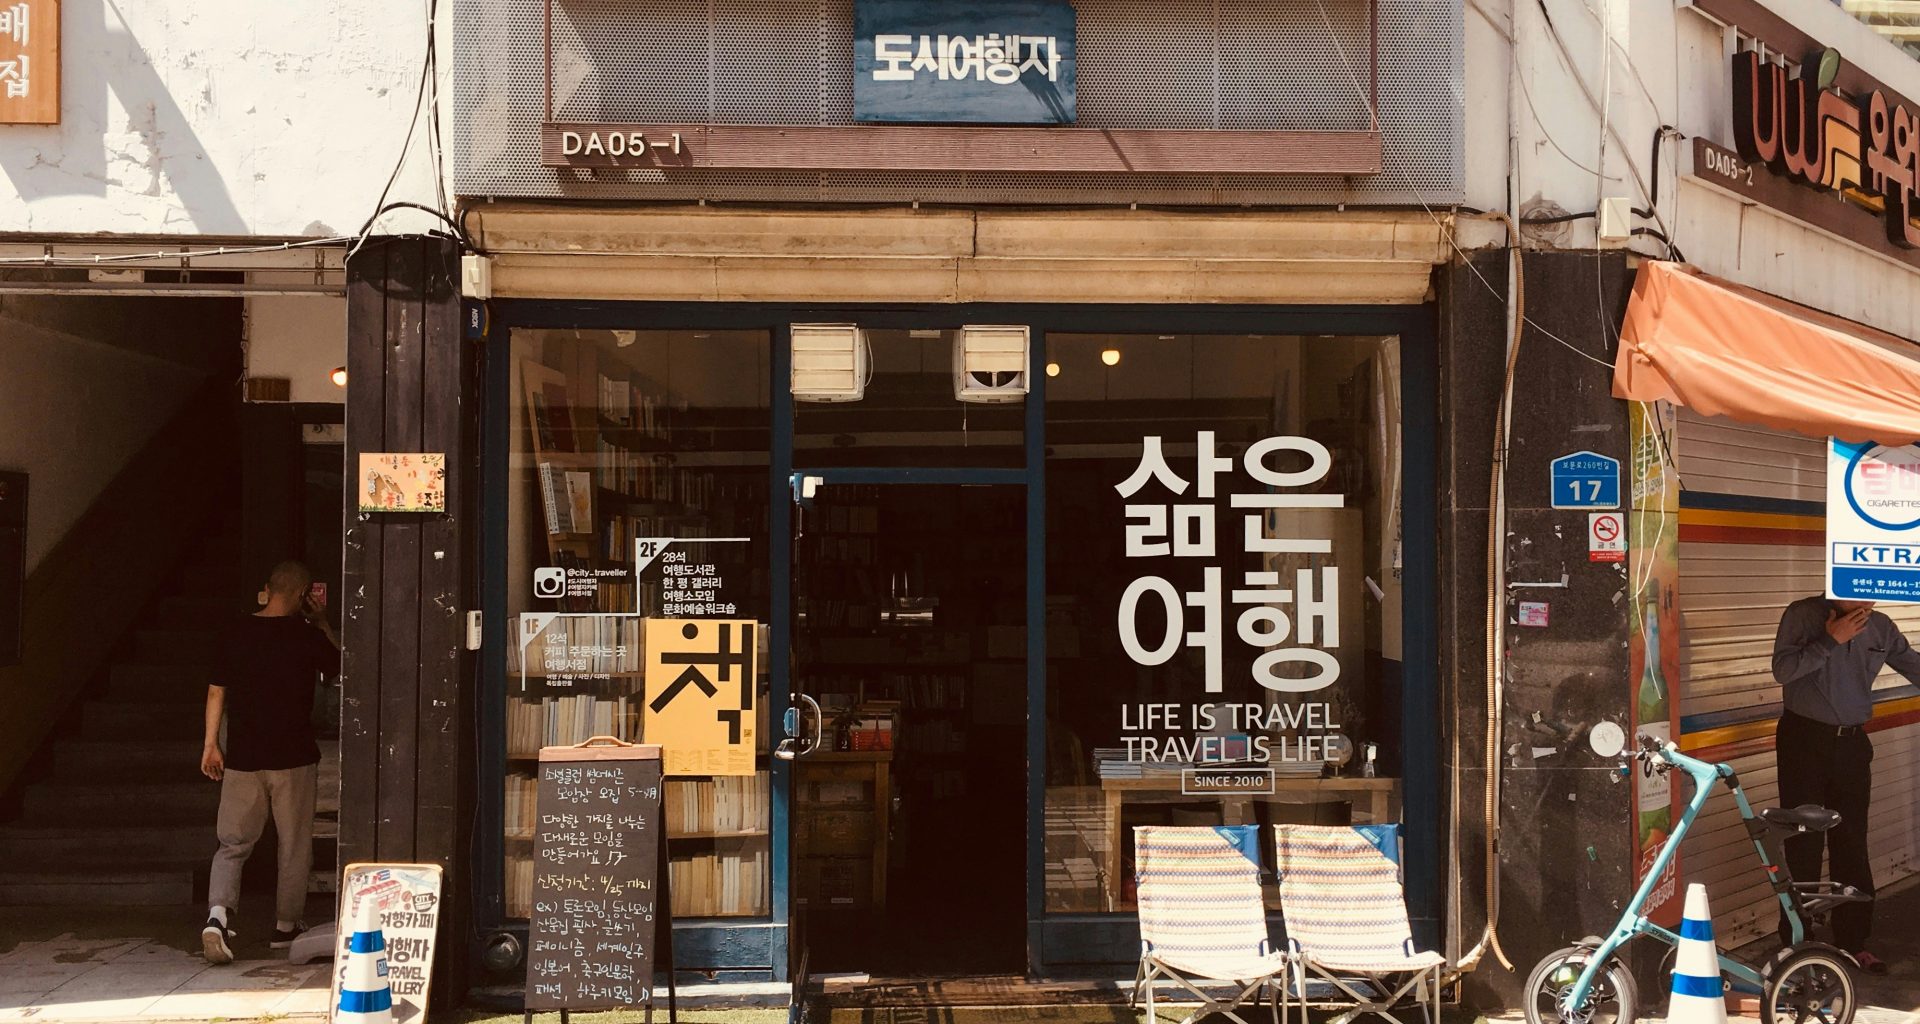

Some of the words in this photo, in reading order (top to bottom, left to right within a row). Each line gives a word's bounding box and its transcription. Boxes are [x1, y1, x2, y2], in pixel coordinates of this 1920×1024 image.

[873, 34, 1060, 85] 도시여행자
[562, 132, 682, 157] DA05-1
[1705, 148, 1754, 187] DA05-2
[1114, 430, 1345, 557] 삶은
[1568, 480, 1602, 502] 17
[639, 541, 658, 559] 2F
[662, 551, 686, 563] 28석
[567, 568, 628, 578] @city_traveller
[662, 564, 716, 576] 여행도서관
[663, 577, 674, 589] 한
[677, 577, 688, 589] 평
[691, 577, 722, 589] 갤러리
[662, 590, 715, 602] 여행소모임
[662, 603, 737, 615] 문화예술워크숍
[525, 618, 540, 634] 1F
[1117, 566, 1341, 693] 여행
[545, 633, 567, 645] 12석
[545, 646, 565, 657] 커피
[569, 645, 612, 657] 주문하는
[616, 645, 627, 657] 곳
[545, 658, 587, 671] 여행서점
[649, 623, 754, 745] 책
[1121, 704, 1181, 730] LIFE
[1192, 703, 1217, 730] IS
[1224, 703, 1341, 729] TRAVEL
[1120, 736, 1237, 763] TRAVEL
[1246, 736, 1271, 762] IS
[1281, 735, 1340, 762] LIFE
[1194, 775, 1230, 787] SINCE
[1234, 775, 1264, 787] 2010
[542, 814, 579, 829] 다양한
[585, 814, 614, 829] 가치를
[619, 816, 646, 830] 나누는
[542, 831, 589, 846] 다채로운
[593, 831, 624, 848] 모임을
[542, 847, 601, 865] 만들어가요
